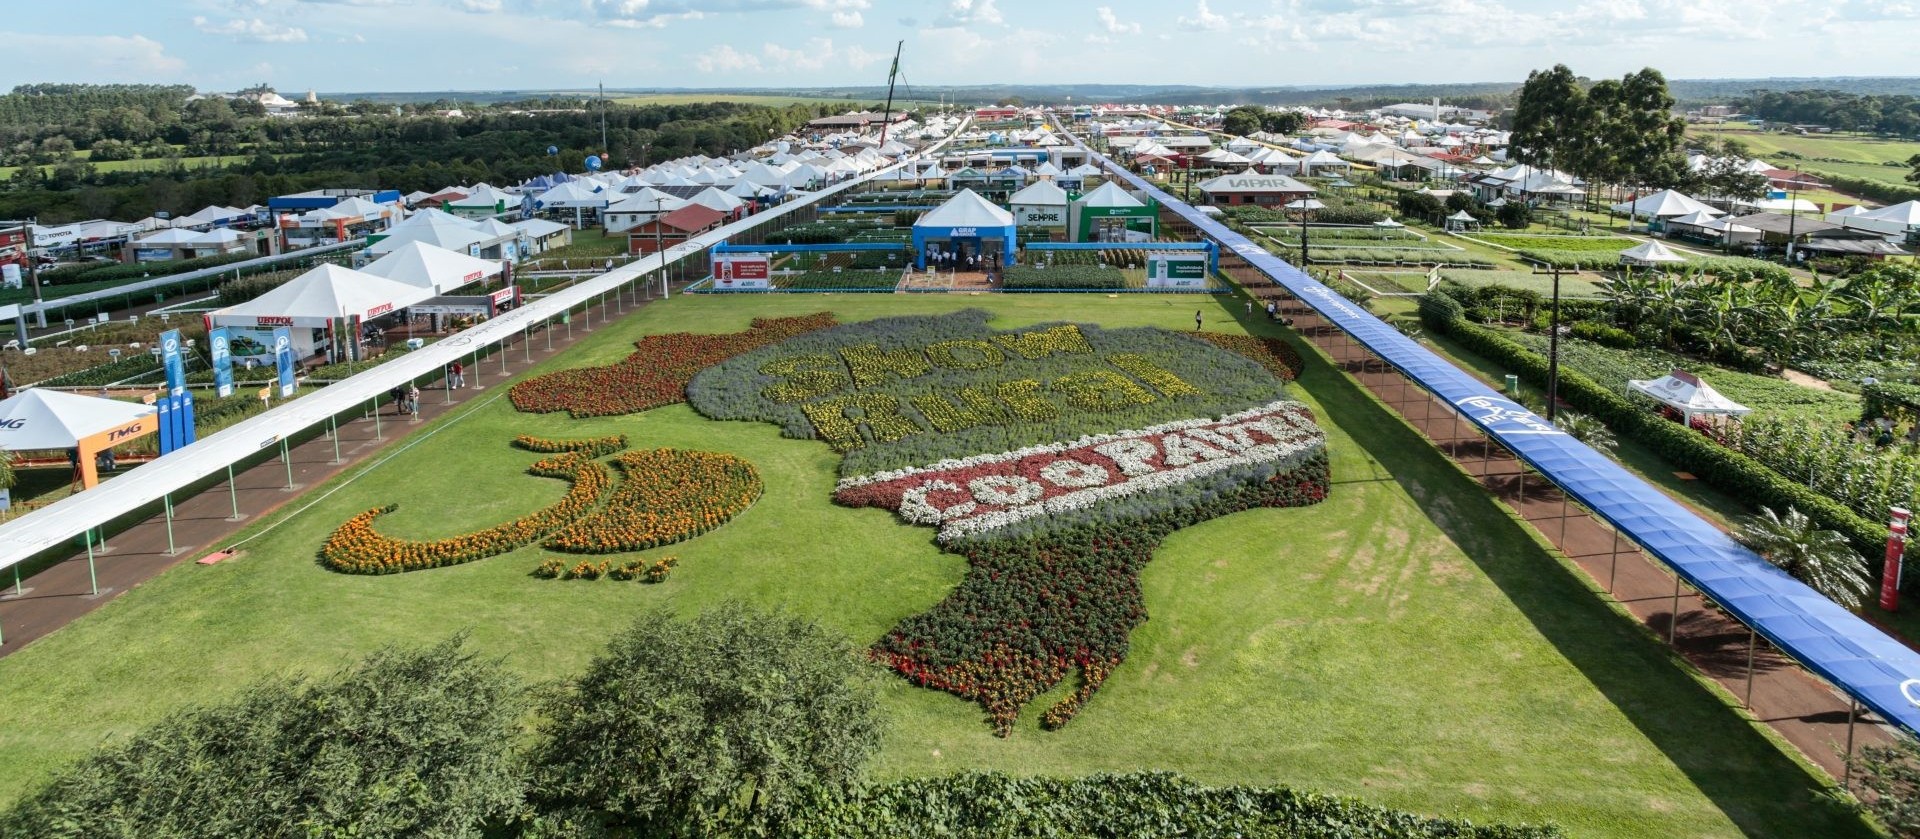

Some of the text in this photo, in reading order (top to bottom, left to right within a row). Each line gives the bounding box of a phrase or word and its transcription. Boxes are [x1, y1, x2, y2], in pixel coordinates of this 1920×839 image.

[1027, 213, 1059, 222] SEMPRE
[48, 230, 72, 239] TOYOTA
[367, 302, 393, 316] UBYFOL
[257, 316, 294, 324] UBYFOL
[107, 422, 142, 441] TMG
